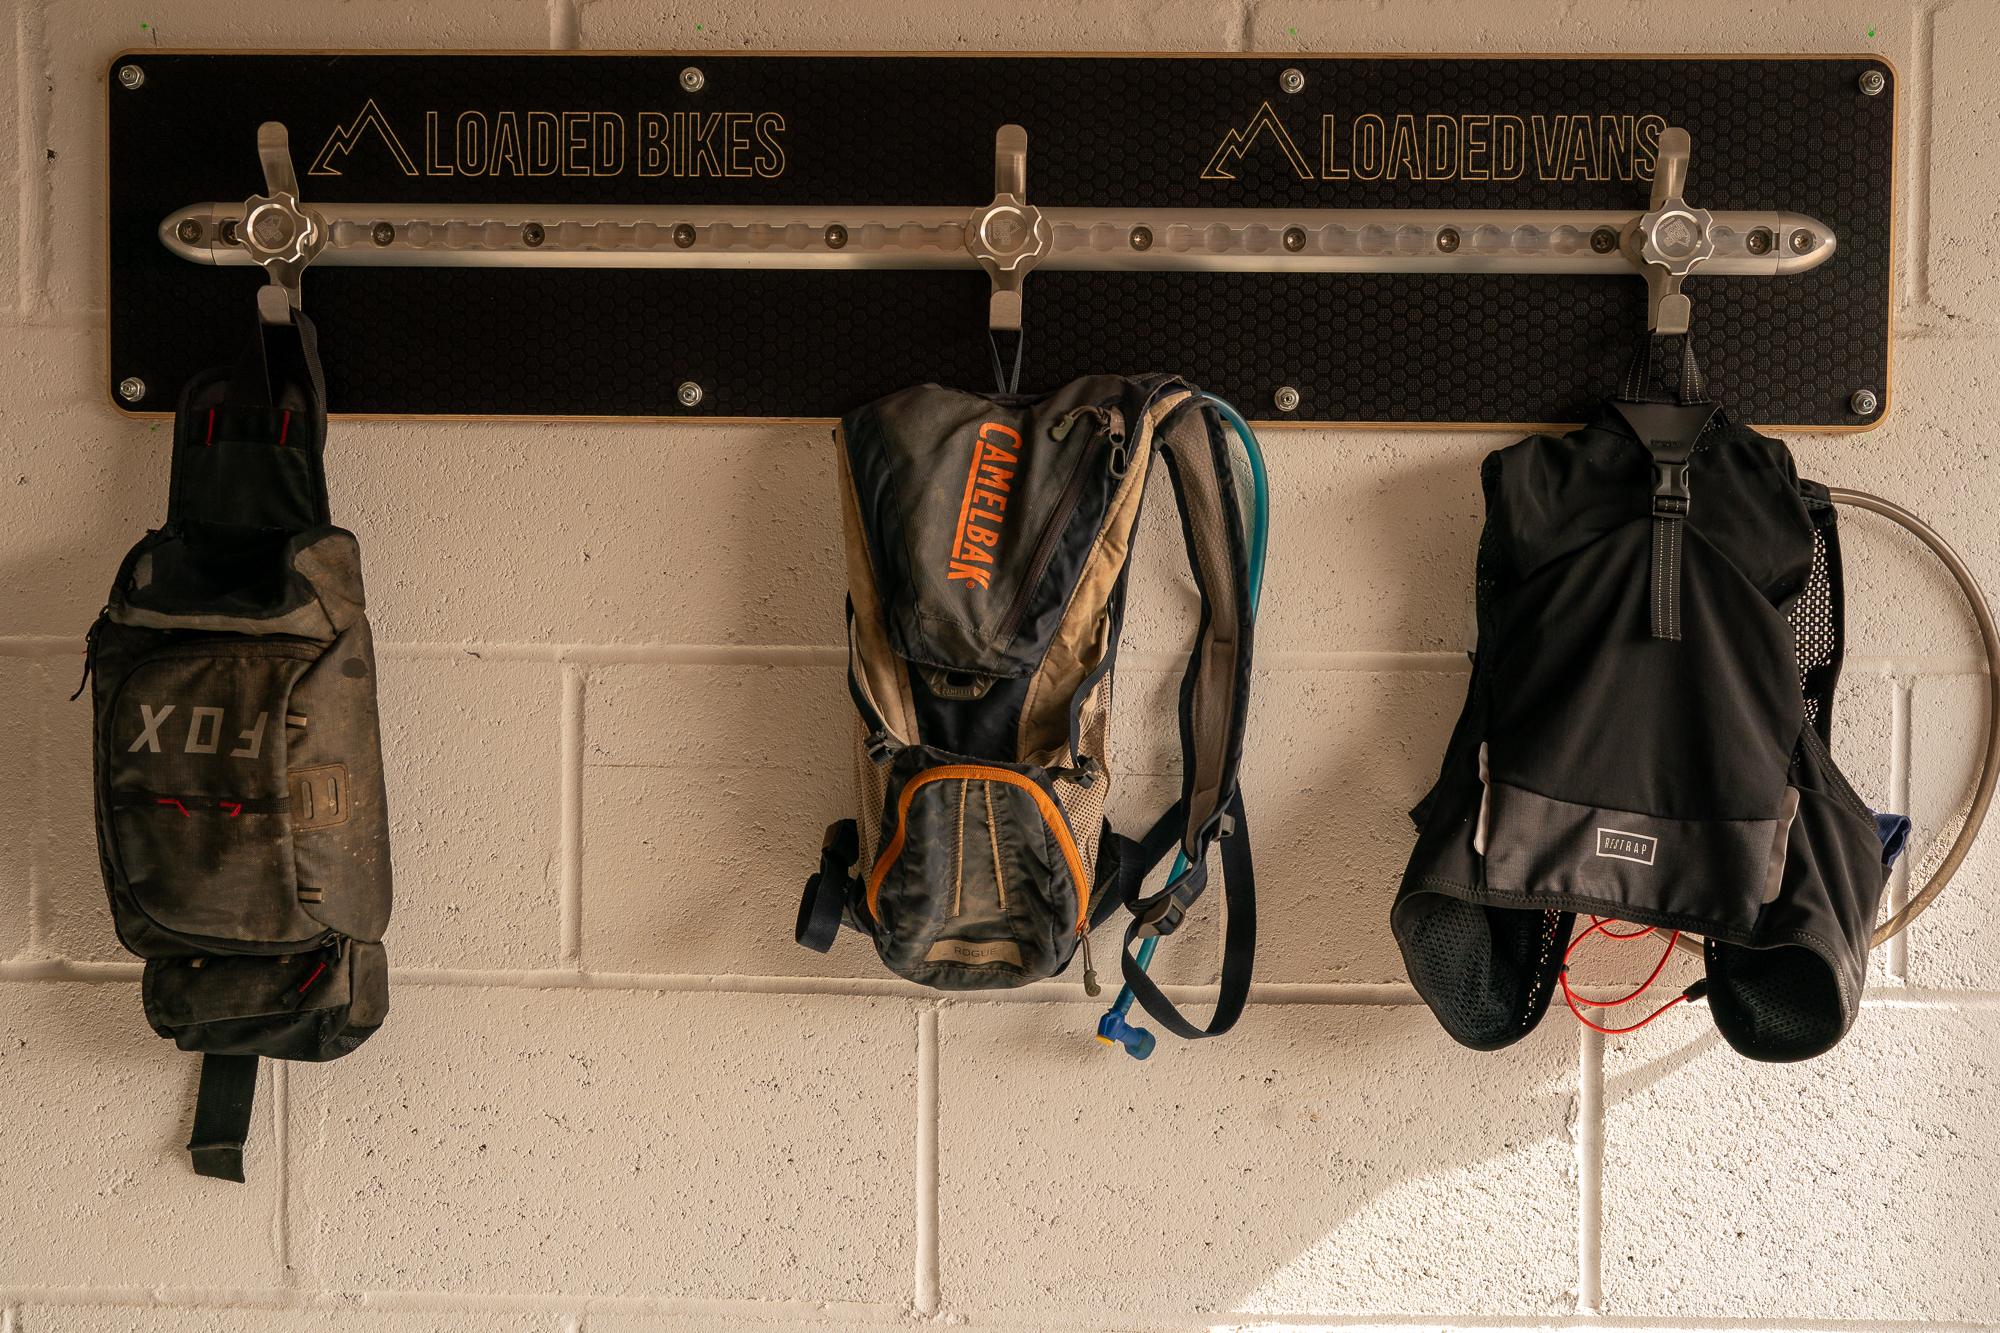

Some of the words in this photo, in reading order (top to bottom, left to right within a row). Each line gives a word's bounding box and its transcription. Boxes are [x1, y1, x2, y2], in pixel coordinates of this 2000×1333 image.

[426, 111, 623, 177] LOADED
[638, 112, 786, 178] BIKES
[1321, 114, 1525, 180] LOADED
[1531, 114, 1667, 181] VANS
[947, 422, 1023, 590] CAMELBAK
[128, 704, 268, 759] FOX
[1604, 837, 1647, 855] RESTRAP
[954, 946, 998, 957] ROGUE
